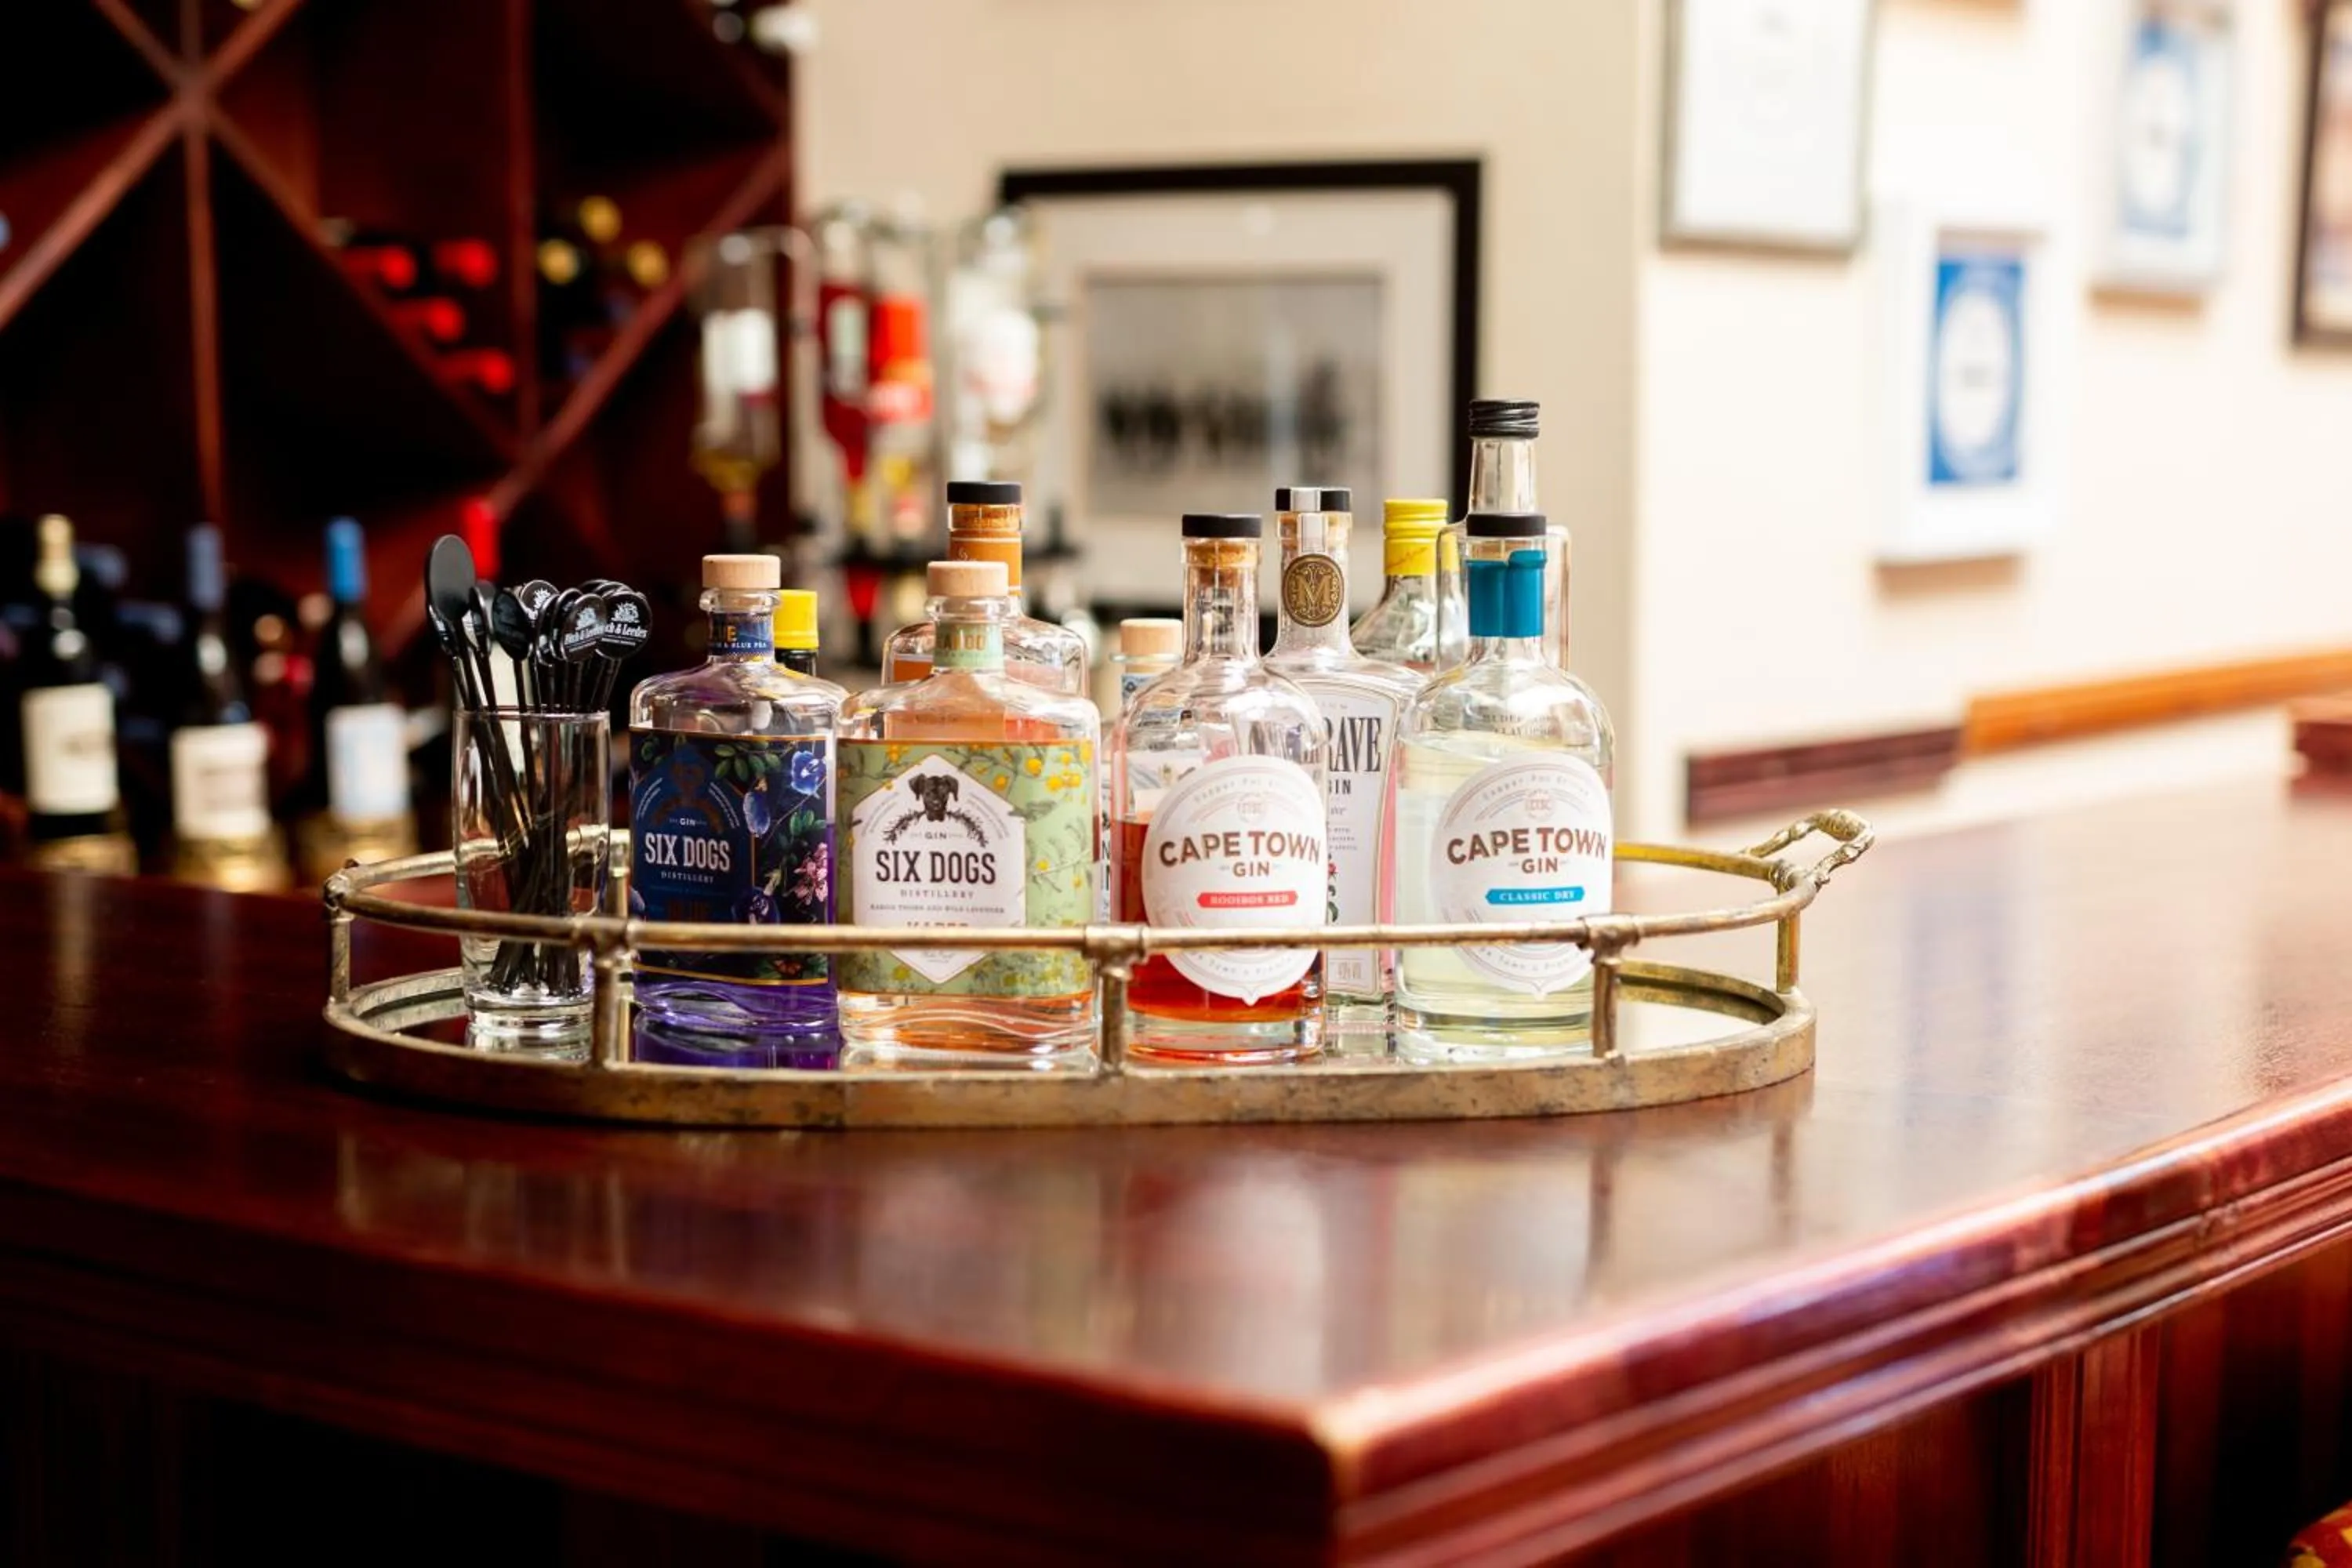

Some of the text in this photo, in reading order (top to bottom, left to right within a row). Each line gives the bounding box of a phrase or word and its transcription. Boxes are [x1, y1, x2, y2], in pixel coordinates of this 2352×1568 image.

[679, 817, 696, 826] GIN
[924, 831, 947, 840] GIN
[644, 832, 731, 873] SIX DOGS
[1159, 832, 1242, 867] CAPE
[1247, 830, 1322, 865] TOWN
[1446, 826, 1607, 866] CAPE TOWN
[876, 849, 996, 885] SIX DOGS
[1232, 862, 1271, 878] GIN
[1521, 858, 1559, 875] GIN
[660, 870, 714, 884] DISTILLERY
[900, 888, 975, 899] DISTILLERY
[1498, 890, 1575, 902] CLASSIC DRY
